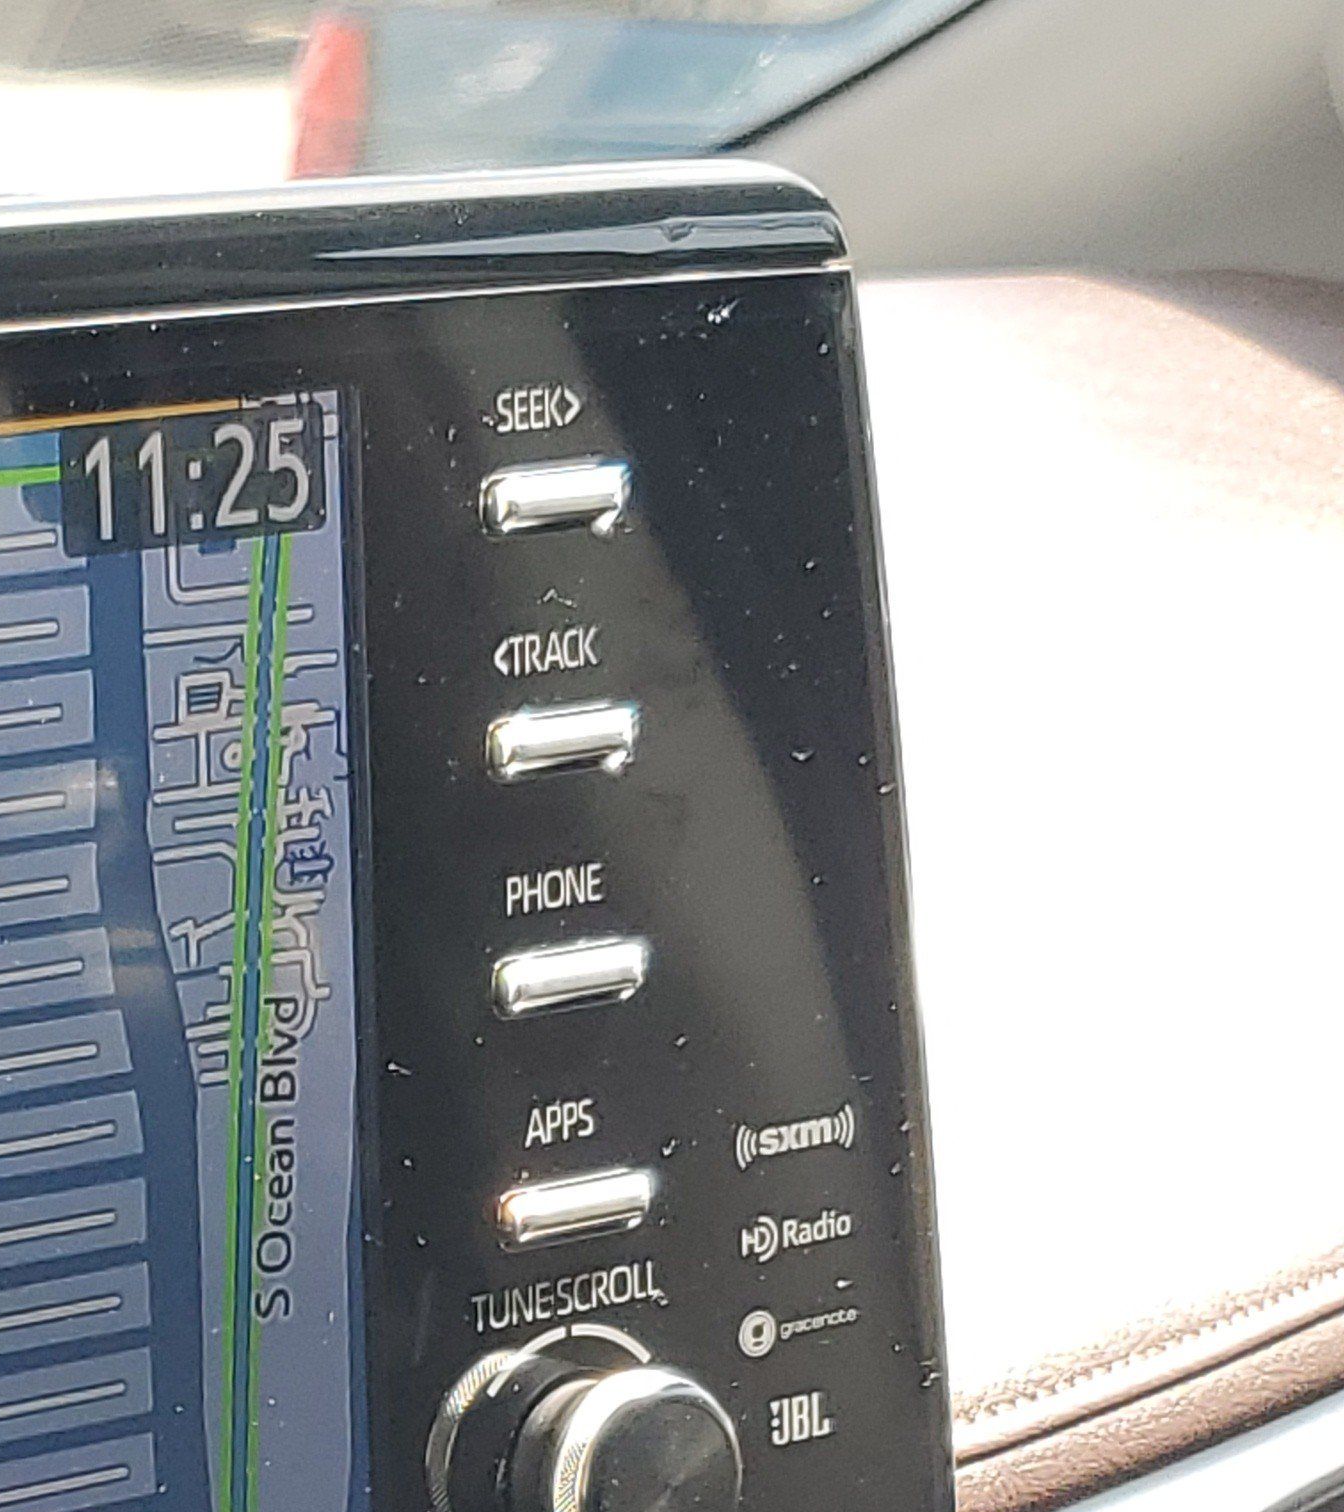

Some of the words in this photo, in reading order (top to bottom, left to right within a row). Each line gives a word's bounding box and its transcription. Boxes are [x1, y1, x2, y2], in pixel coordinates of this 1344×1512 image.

[84, 416, 311, 542] 11:25
[505, 864, 604, 915] PHONE
[259, 996, 300, 1105] Blvd
[524, 1099, 594, 1148] APPS
[256, 1118, 296, 1273] Ocean
[783, 1210, 852, 1248] Radio
[256, 1286, 289, 1319] S
[471, 1282, 553, 1333] TUNE
[557, 1260, 656, 1315] SCROLL
[769, 1391, 831, 1445] JBL
